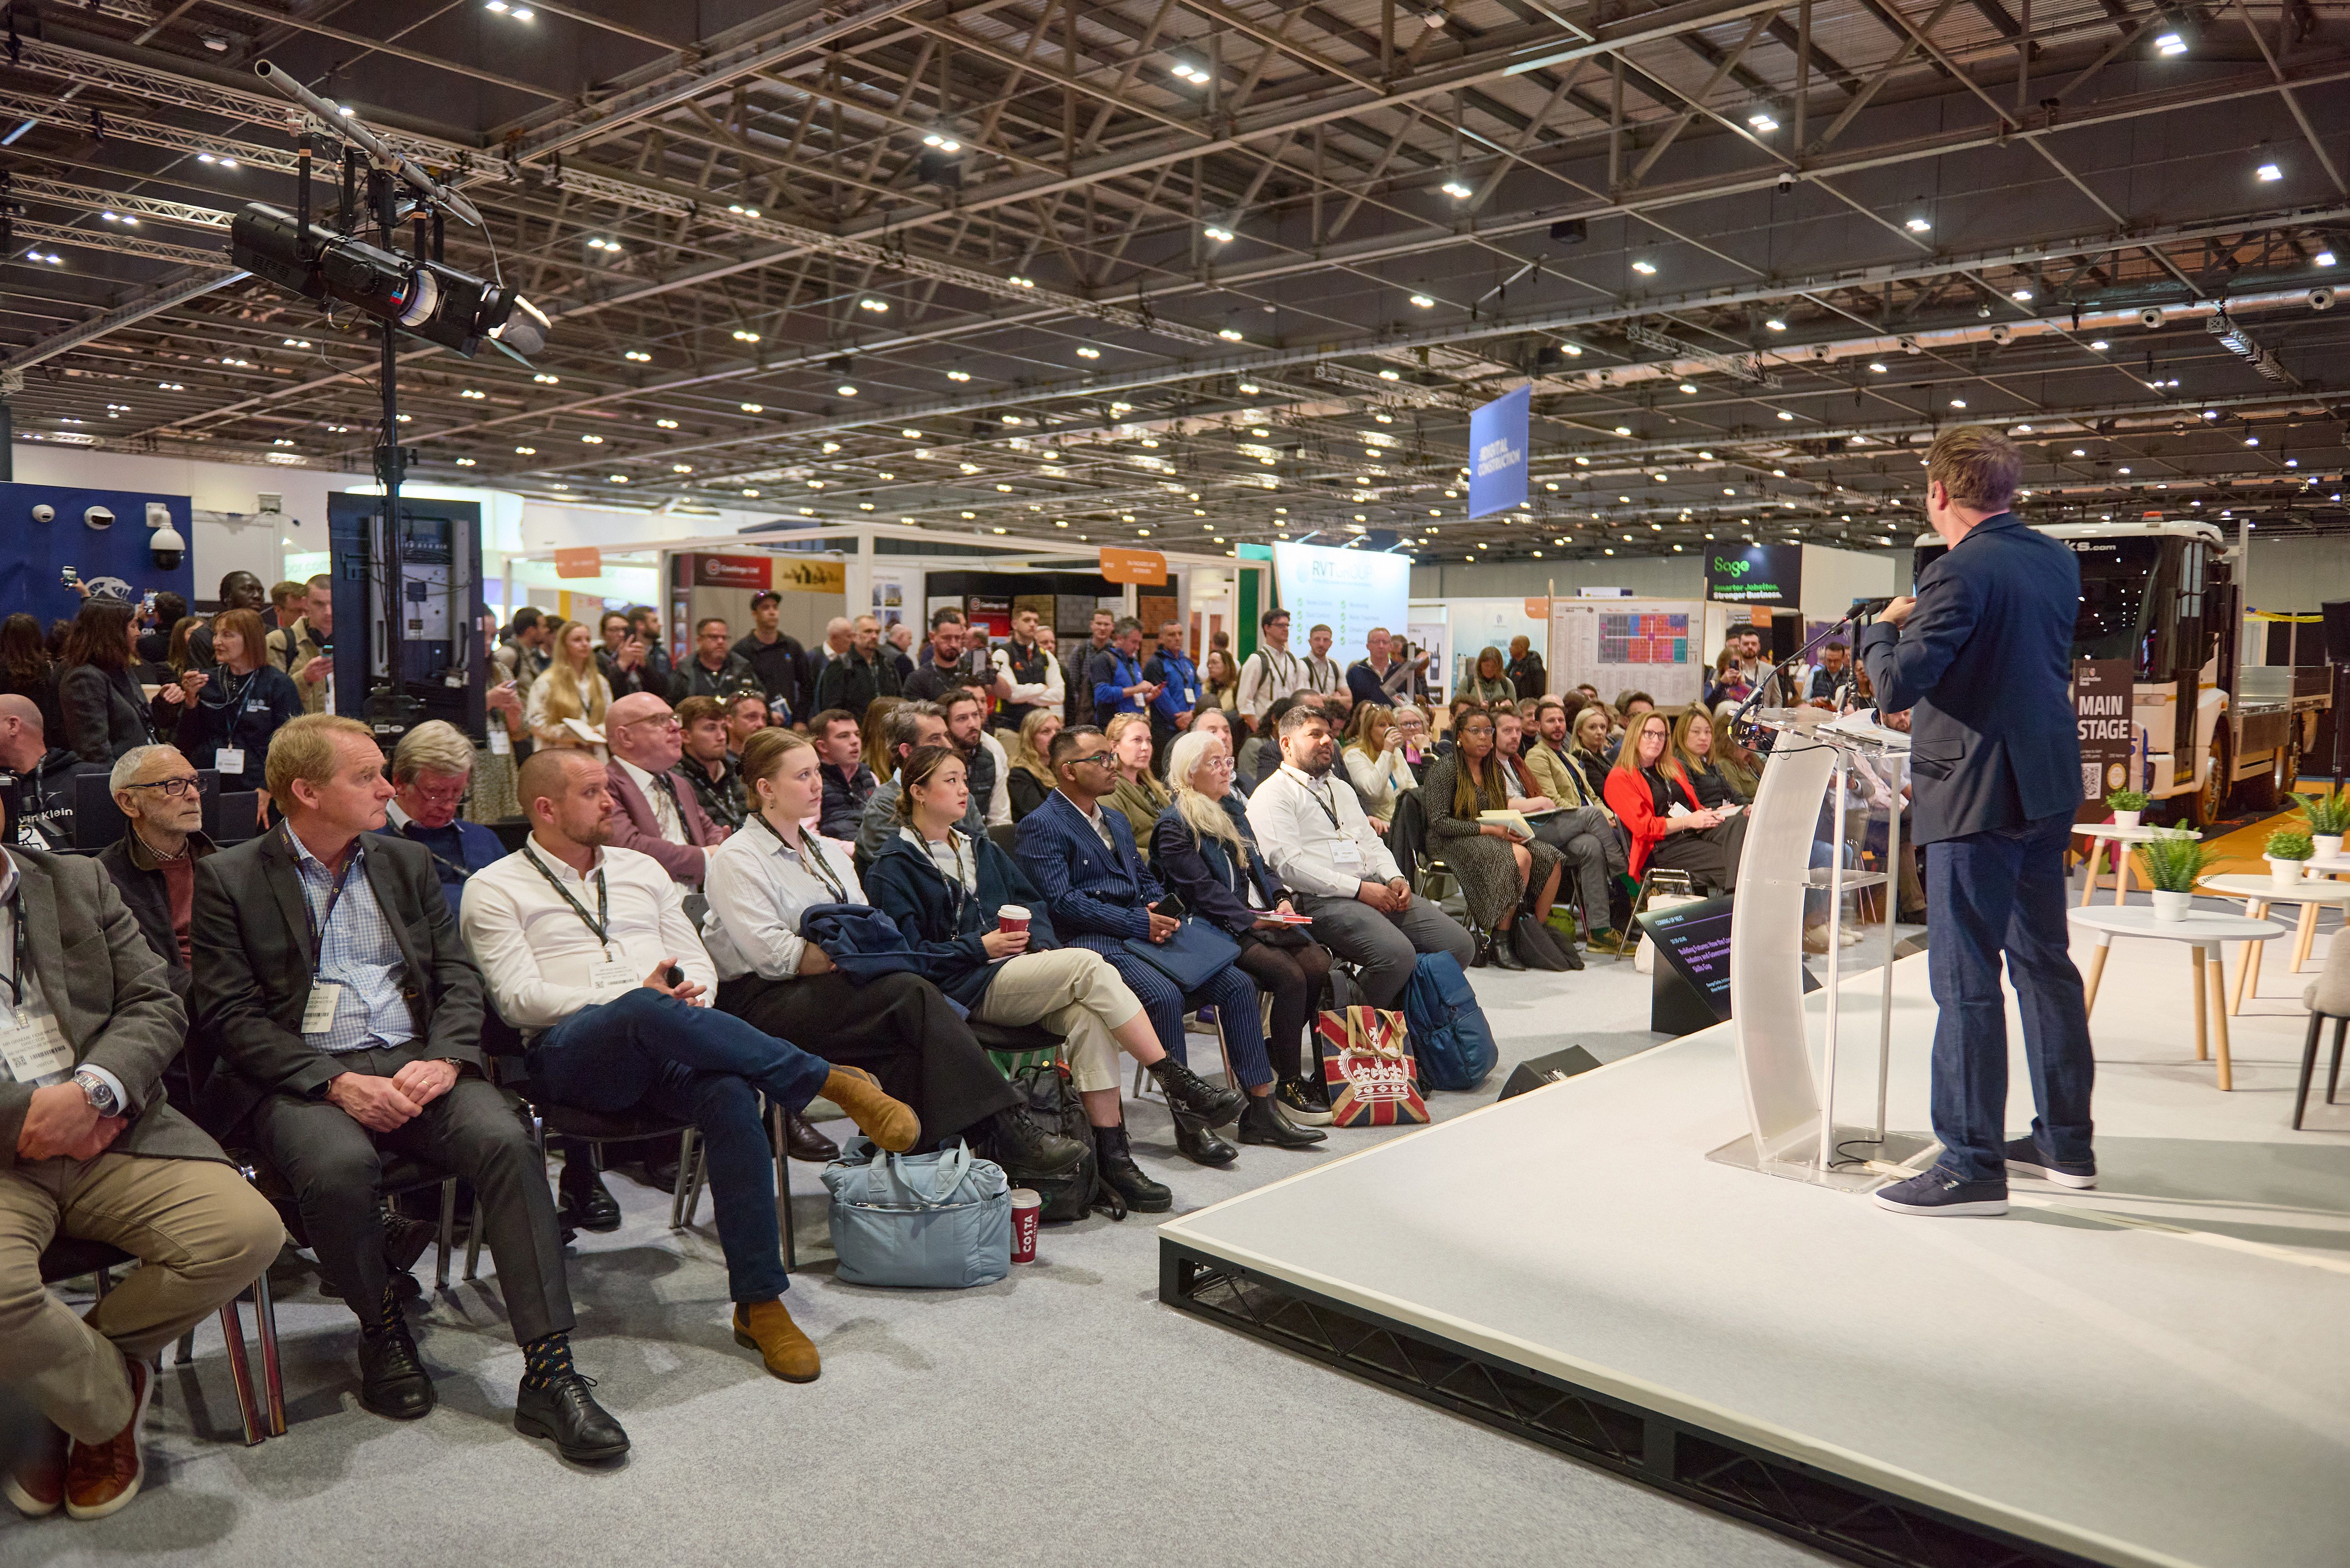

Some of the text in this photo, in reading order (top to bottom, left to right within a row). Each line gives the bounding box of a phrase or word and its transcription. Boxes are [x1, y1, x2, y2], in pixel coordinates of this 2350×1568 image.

[1714, 556, 1750, 578] Sage
[1714, 590, 1783, 601] Stronger Business.
[2078, 696, 2123, 716] MAIN
[2077, 719, 2129, 740] STAGE
[42, 808, 73, 820] Klein
[11, 1036, 31, 1044] GRAEME
[21, 1037, 45, 1046] DIRECTOR
[36, 1060, 54, 1068] VISITOR
[1023, 1214, 1033, 1252] COSTA
